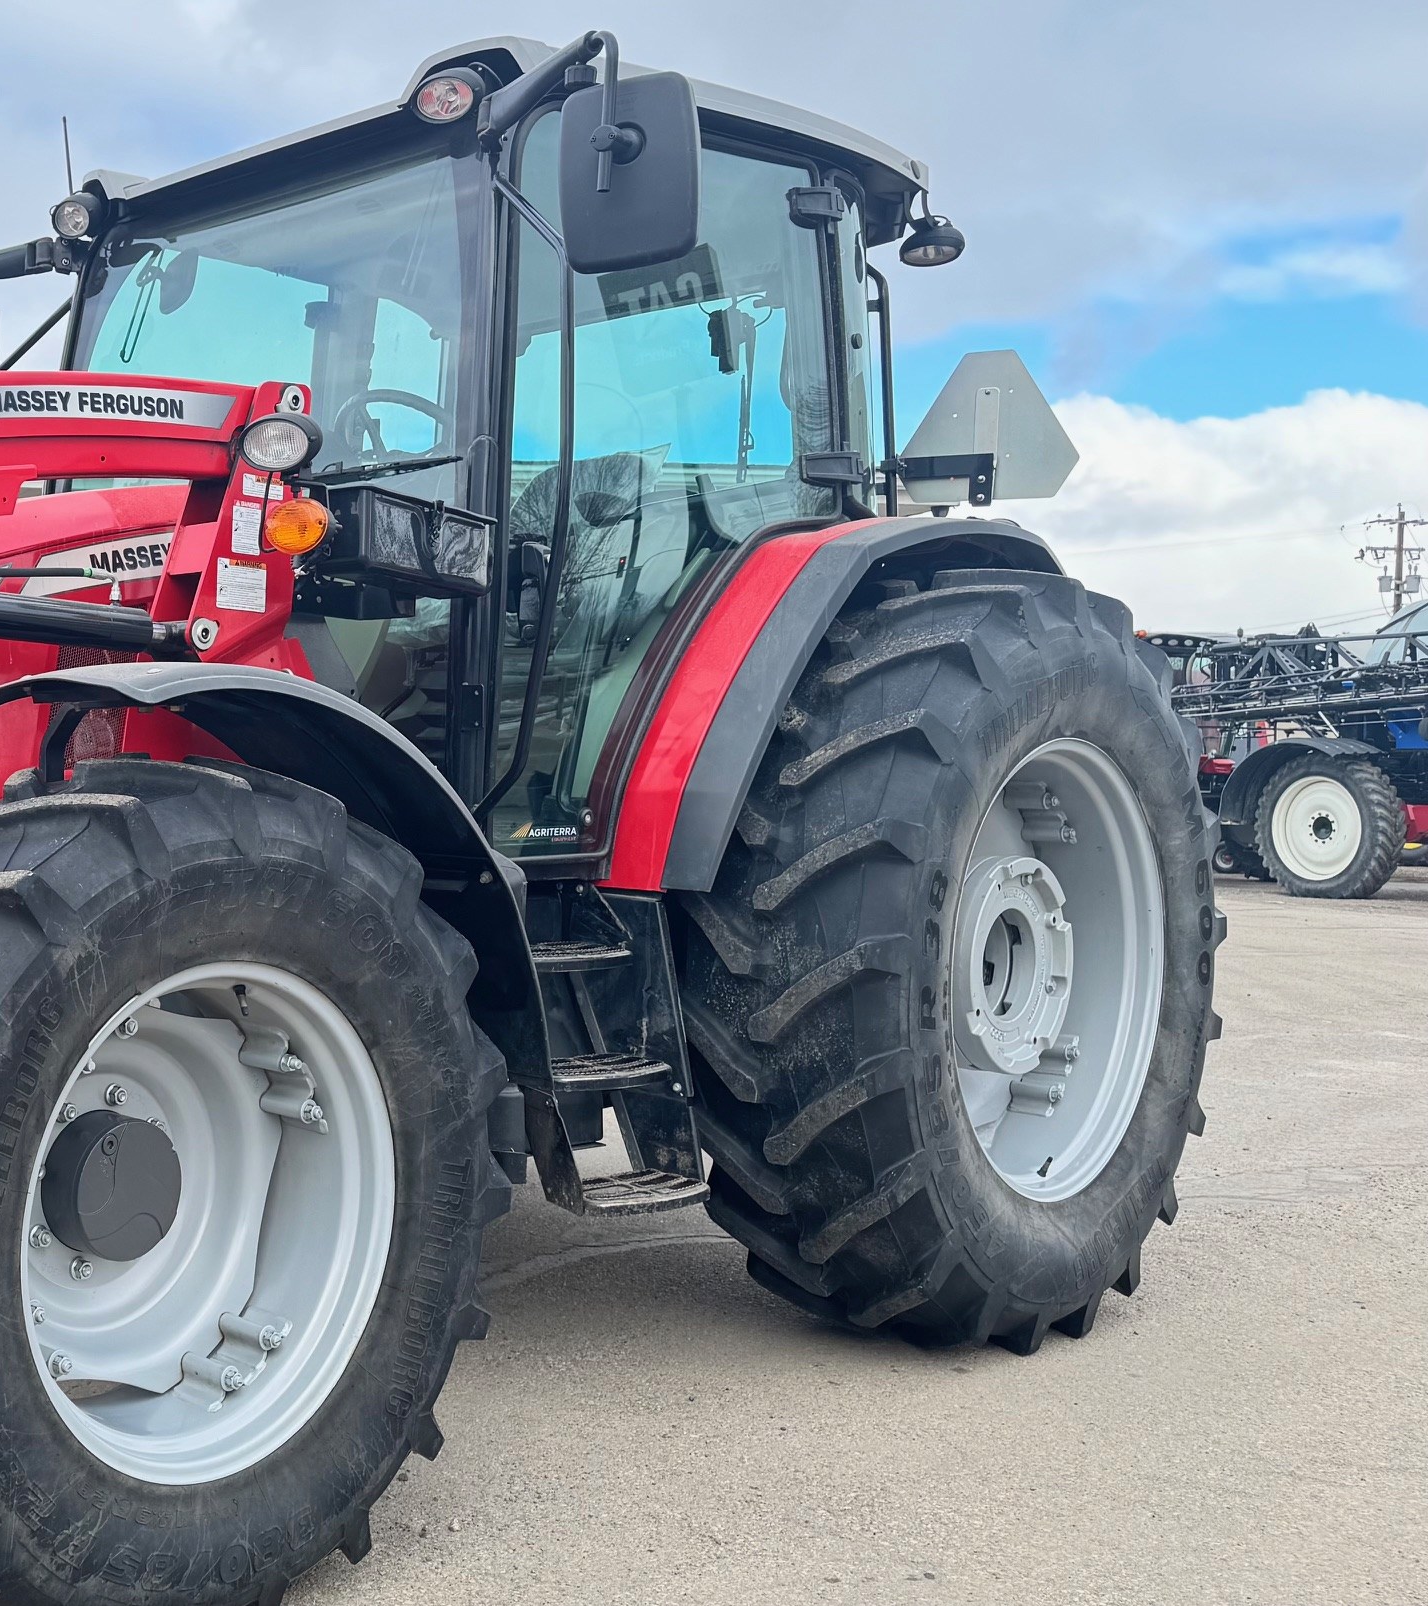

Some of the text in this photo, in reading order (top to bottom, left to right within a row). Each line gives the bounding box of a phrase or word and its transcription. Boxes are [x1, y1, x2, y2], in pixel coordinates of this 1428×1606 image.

[78, 391, 184, 419] FERGUSON
[528, 827, 577, 838] AGRITERRA
[384, 1156, 474, 1420] TRELLEBORG
